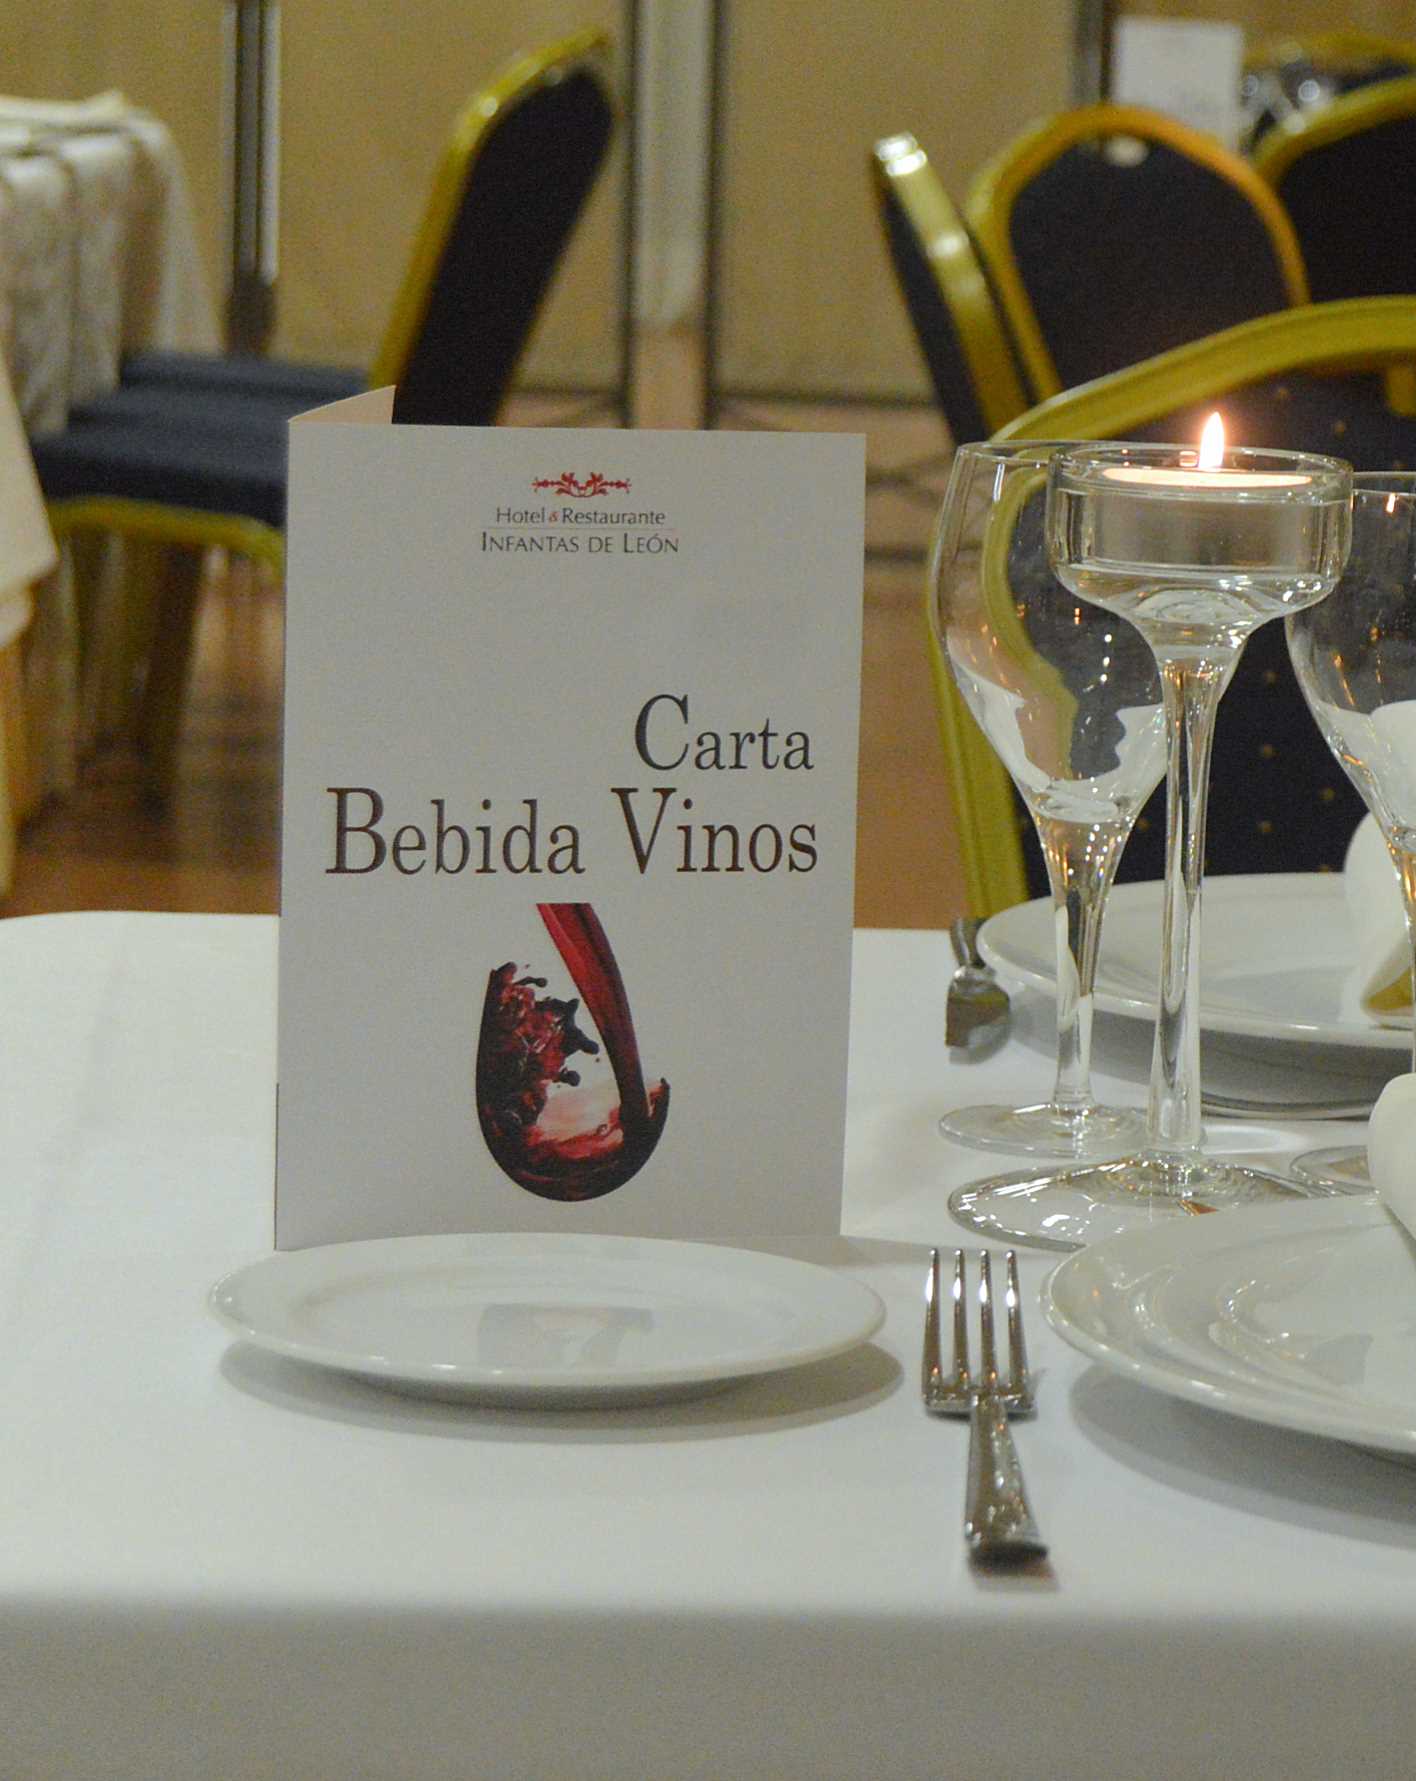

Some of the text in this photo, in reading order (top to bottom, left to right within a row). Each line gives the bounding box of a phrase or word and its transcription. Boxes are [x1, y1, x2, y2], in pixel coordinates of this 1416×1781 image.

[497, 507, 545, 523] Hotel
[562, 508, 666, 525] Restaurante
[482, 531, 679, 553] INFANTAS DE LEÓN
[633, 693, 815, 772] Carta
[324, 786, 819, 876] Bebida Vinos
